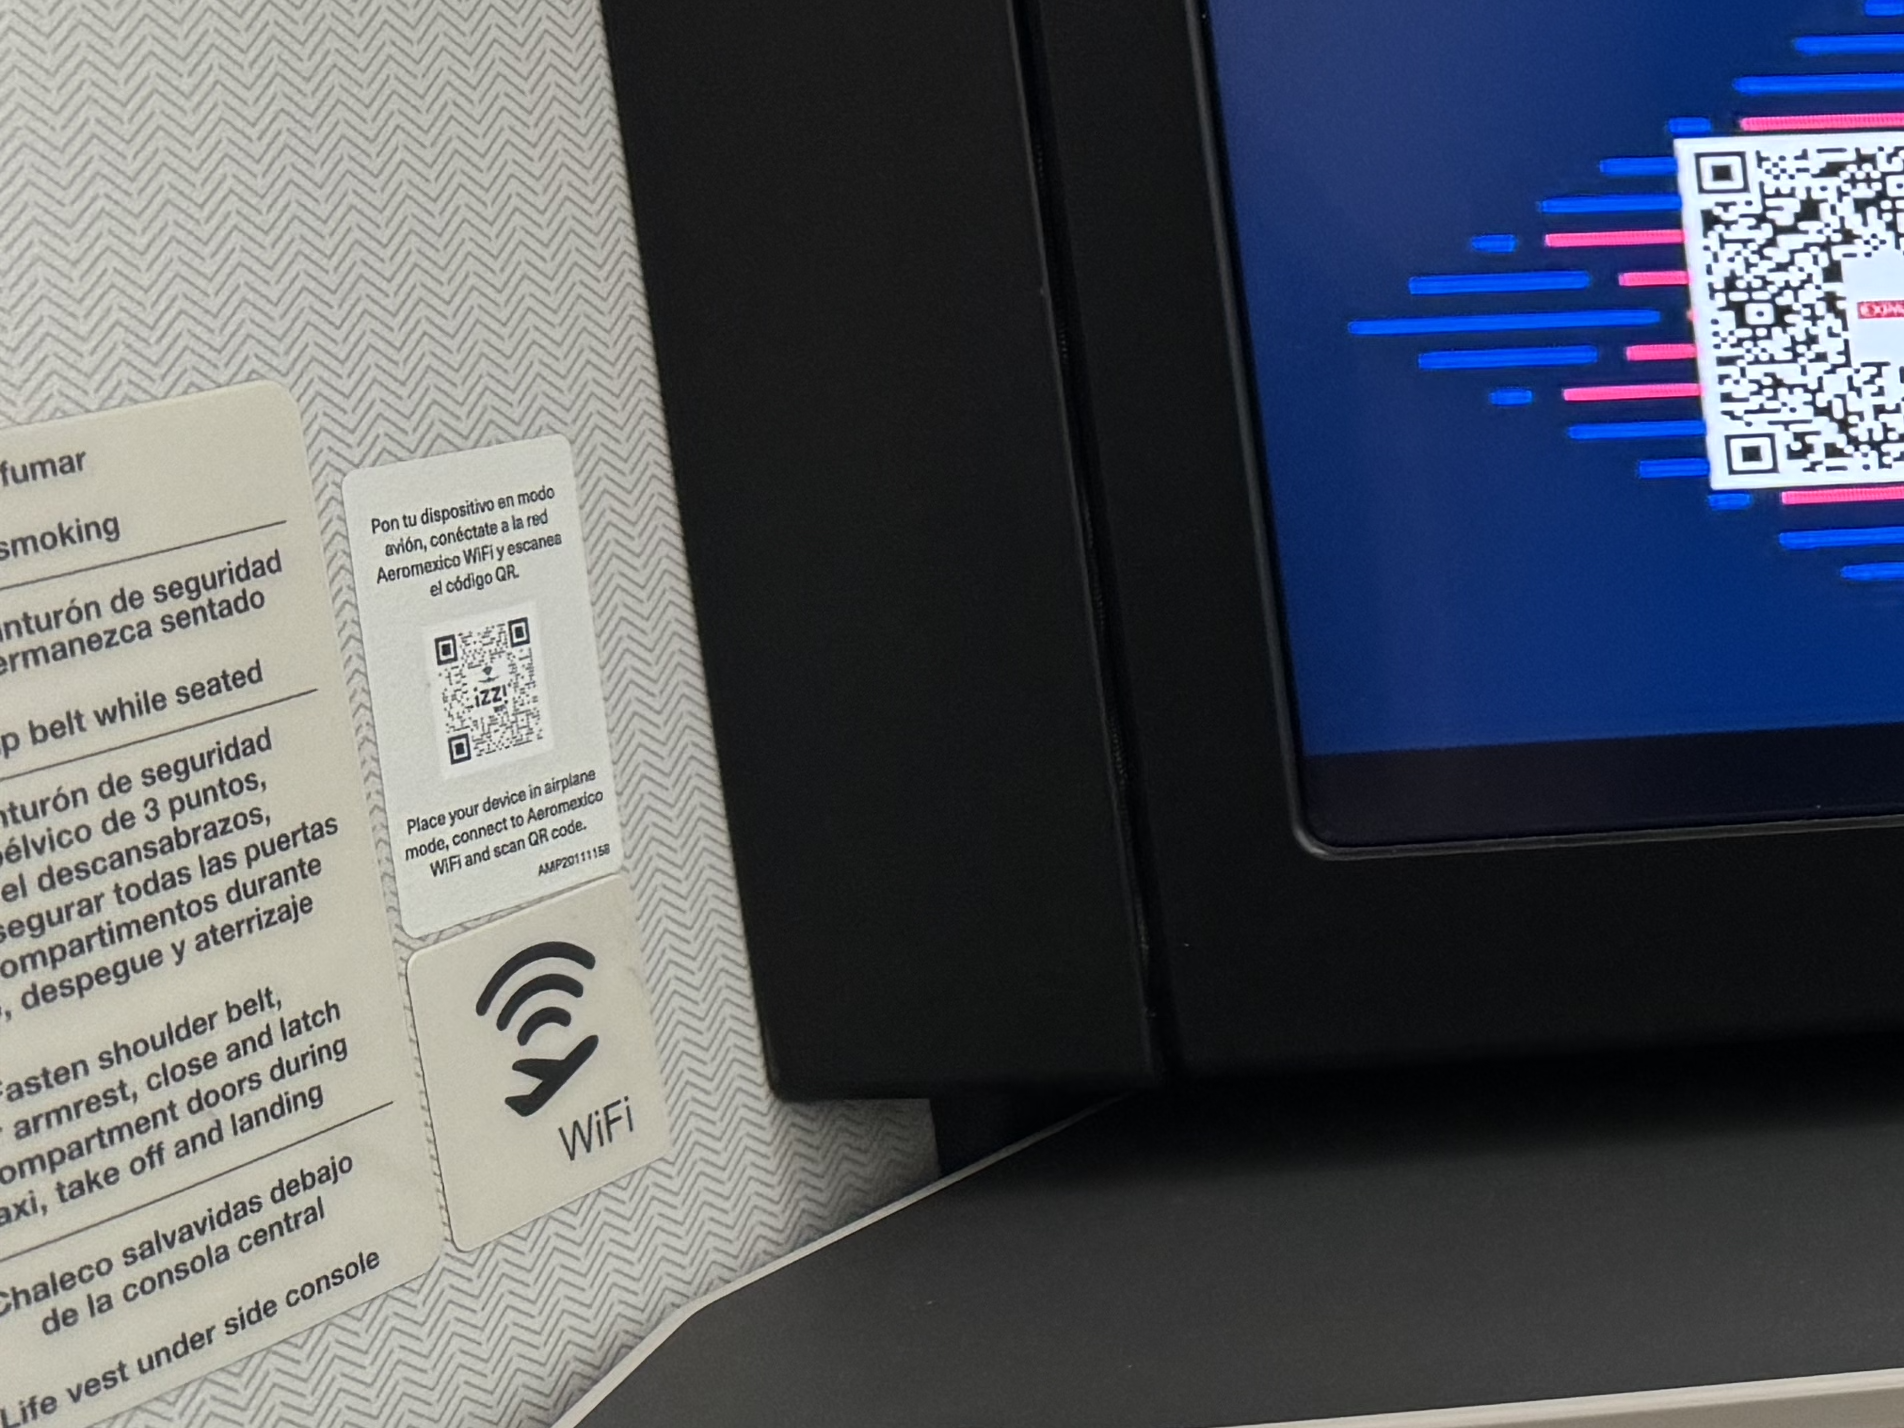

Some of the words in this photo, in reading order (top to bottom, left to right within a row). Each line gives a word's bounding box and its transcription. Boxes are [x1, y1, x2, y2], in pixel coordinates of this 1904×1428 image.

[0, 450, 86, 487] fumar
[370, 517, 400, 535] Pon
[401, 513, 418, 529] tu
[419, 497, 495, 525] dispositivo
[496, 494, 515, 510] en
[516, 484, 555, 506] modo
[375, 553, 461, 585] Aeromexico
[461, 543, 494, 565] WiFi
[495, 544, 505, 562] y
[506, 532, 562, 556] escanea
[384, 535, 428, 557] avión,
[428, 521, 498, 548] conéctate
[500, 519, 510, 533] a
[510, 513, 525, 531] la
[525, 506, 549, 528] red
[109, 585, 144, 614] de
[151, 547, 282, 604] seguridad
[428, 578, 443, 597] el
[444, 571, 493, 594] código
[0, 619, 153, 676] ermanezca
[159, 586, 265, 634] sentado
[27, 708, 87, 746] belt
[92, 688, 167, 727] while
[174, 657, 263, 705] seated
[96, 771, 132, 800] de
[140, 725, 272, 788] seguridad
[405, 812, 446, 836] Place
[447, 802, 479, 828] your
[481, 789, 527, 813] device
[527, 783, 542, 800] in
[543, 768, 596, 795] airplane
[0, 822, 92, 867] élvico
[100, 807, 136, 836] de
[142, 796, 161, 823] 3
[167, 771, 267, 822] puntos,
[0, 871, 28, 903] el
[36, 805, 271, 893] descansabrazos,
[111, 865, 192, 906] todas
[197, 850, 237, 879] las
[243, 816, 338, 869] puertas
[404, 836, 450, 862] mode,
[450, 816, 509, 847] connect
[508, 813, 525, 829] to
[526, 789, 604, 825] Aeromexico
[428, 853, 462, 878] WiFi
[463, 844, 491, 867] and
[492, 837, 526, 859] scan
[526, 826, 549, 847] QR
[0, 892, 219, 979] ompartimentos
[224, 856, 322, 905] durante
[20, 947, 164, 1011] despegue
[169, 938, 185, 967] y
[194, 893, 313, 952] aterrizaje
[0, 1058, 90, 1103] asten
[97, 1009, 219, 1071] shoulder
[224, 985, 282, 1025] belt,
[12, 1078, 138, 1141] armrest,
[145, 1050, 218, 1092] close
[224, 1022, 274, 1063] and
[278, 1000, 341, 1042] latch
[0, 1098, 180, 1185] ompartment
[185, 1071, 262, 1115] doors
[268, 1036, 348, 1083] during
[0, 1188, 48, 1228] axi,
[54, 1165, 120, 1204] take
[128, 1140, 165, 1176] off
[173, 1117, 224, 1159] and
[229, 1083, 324, 1137] landing
[558, 1095, 634, 1161] WiFi
[121, 1193, 263, 1267] salvavidas
[269, 1154, 353, 1205] debajo
[40, 1306, 79, 1336] de
[85, 1292, 114, 1318] la
[121, 1243, 230, 1303] consola
[237, 1194, 325, 1254] central
[65, 1359, 130, 1404] vest
[136, 1324, 216, 1375] under
[223, 1298, 278, 1336] side
[284, 1250, 380, 1308] console
